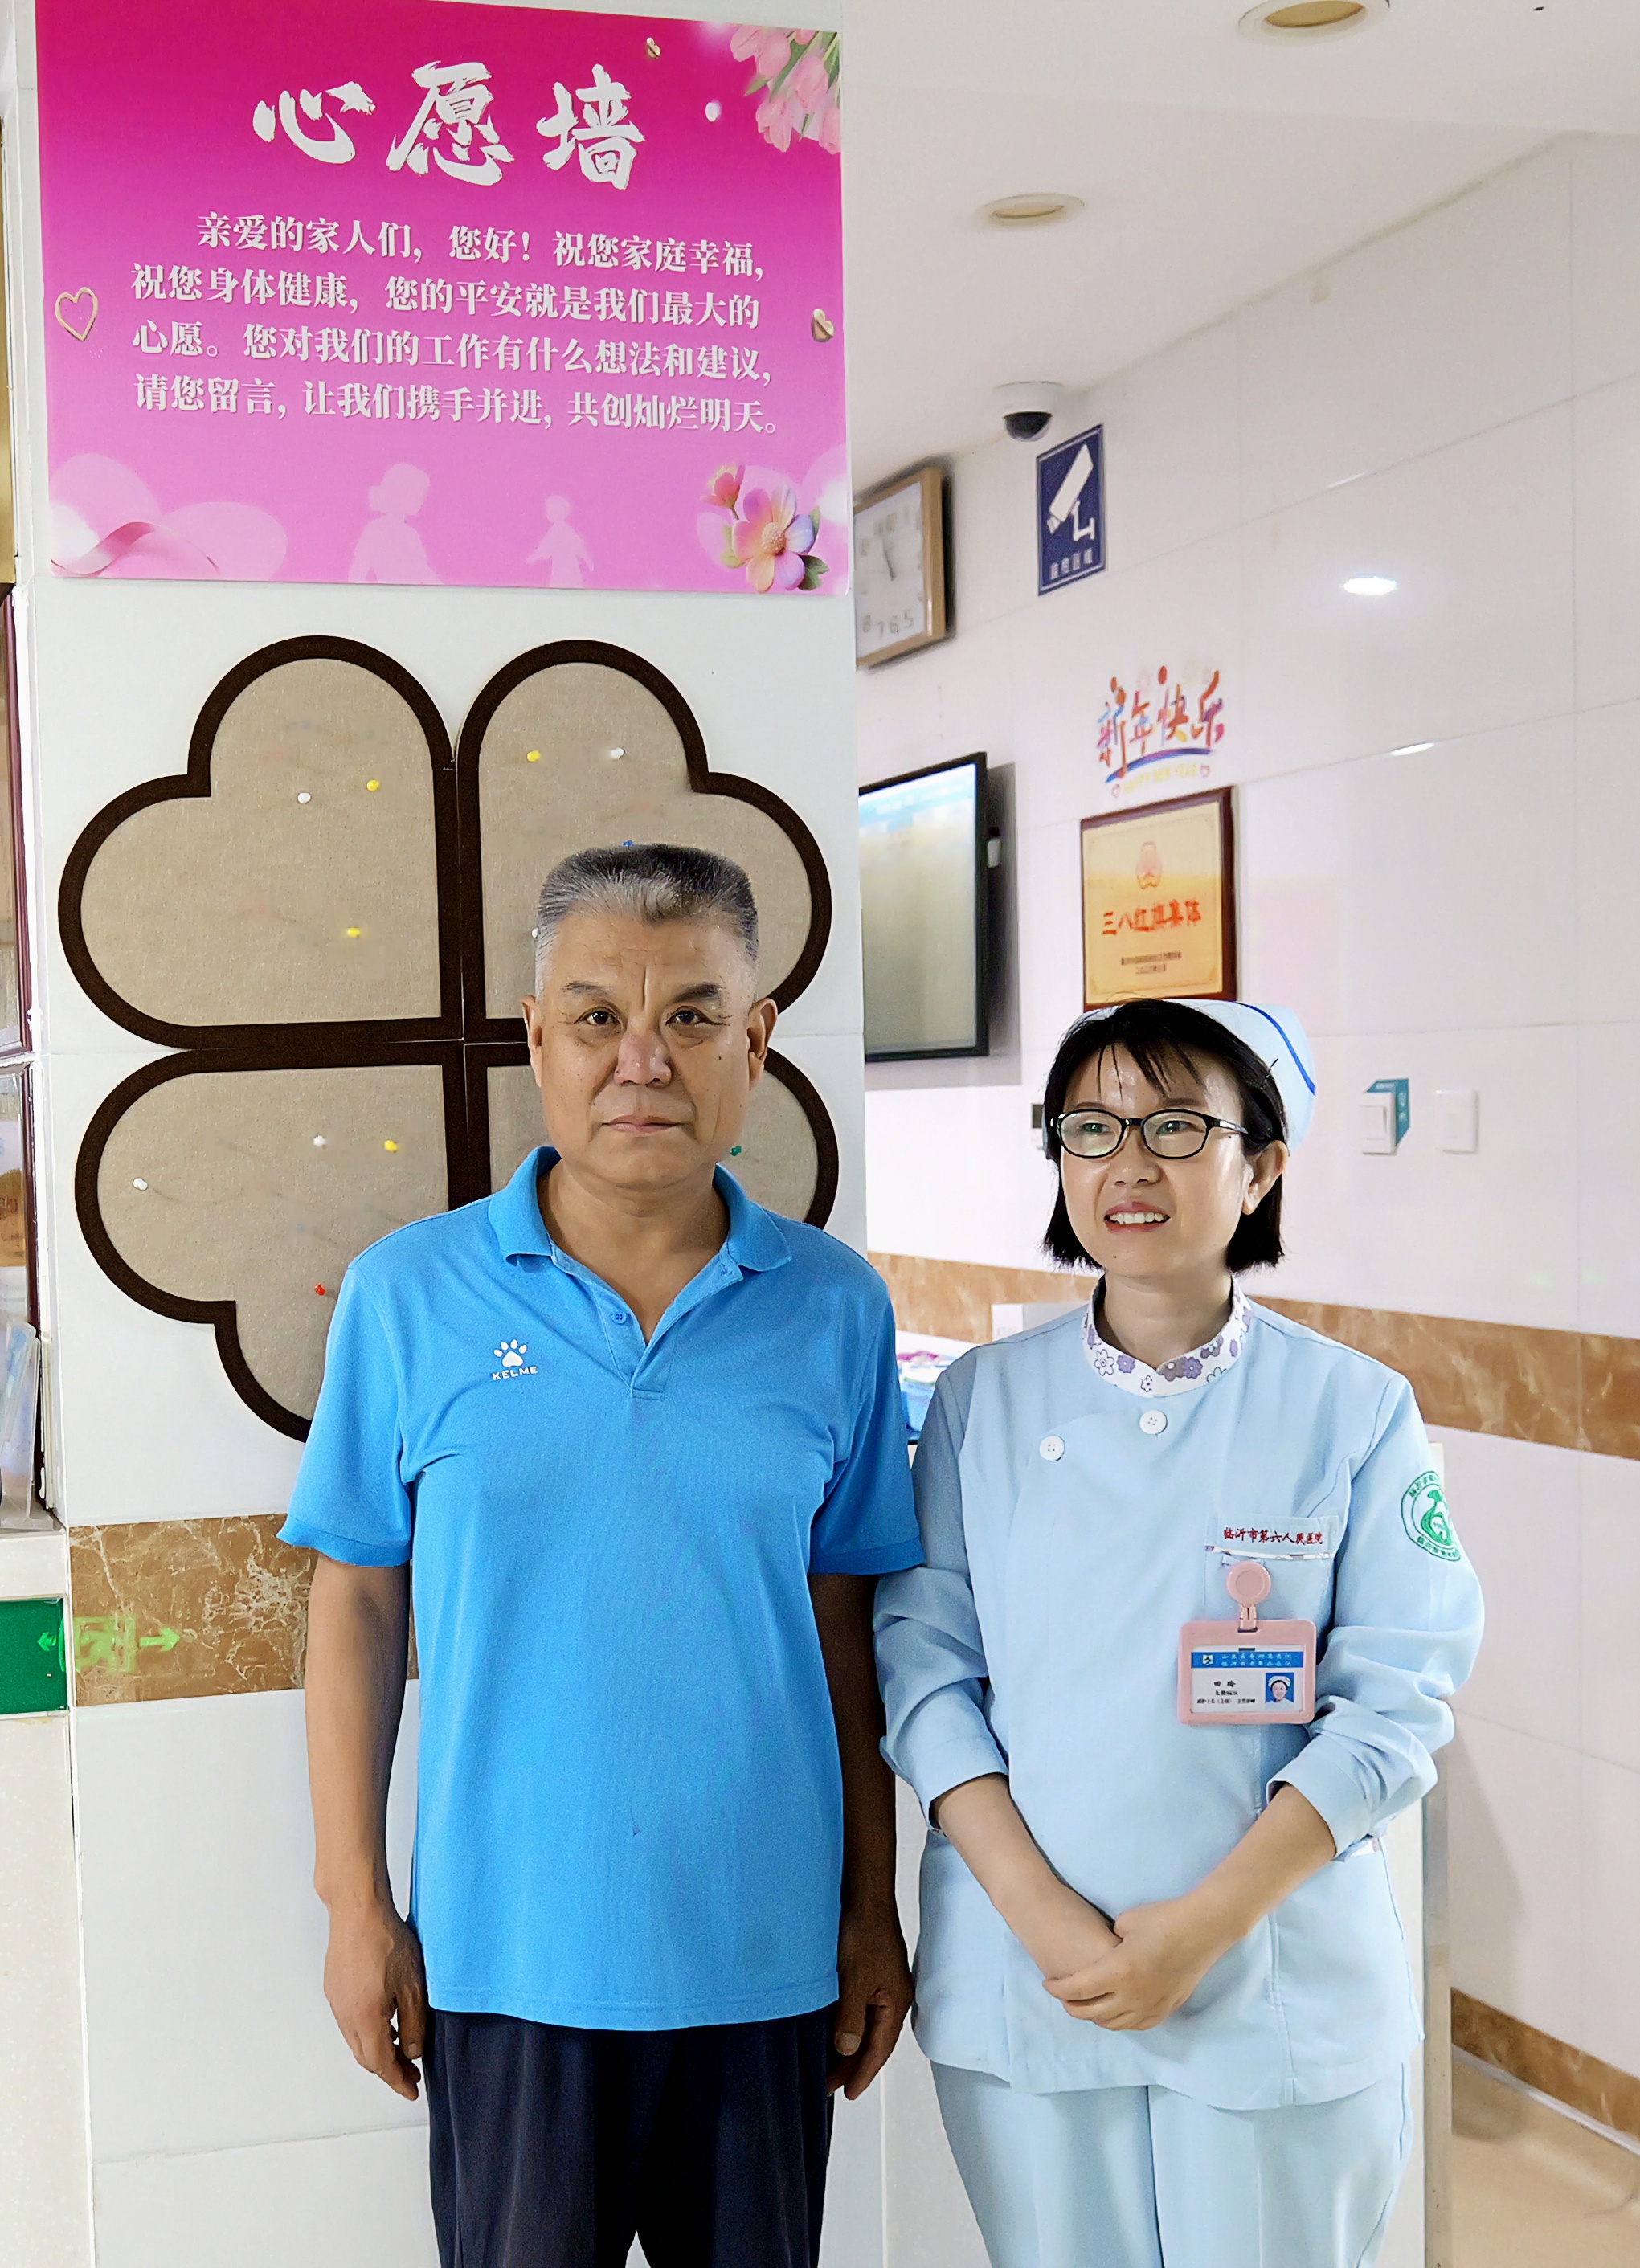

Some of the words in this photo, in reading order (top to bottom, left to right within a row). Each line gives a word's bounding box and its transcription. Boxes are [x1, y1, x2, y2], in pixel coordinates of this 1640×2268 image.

[252, 61, 645, 190] 心愿墙
[197, 211, 763, 282] 亲爱的家人们，您好！祝您家庭幸福，
[130, 263, 760, 329] 祝您身体健康，您的平安就是我们最大的
[132, 320, 771, 386] 心愿。您对我们的工作有什么想法和建议，
[133, 374, 775, 435] 请您留言，让我们携手并进，共创灿烂明天。
[1096, 666, 1225, 778] 新年快乐
[492, 1366, 538, 1381] KELME
